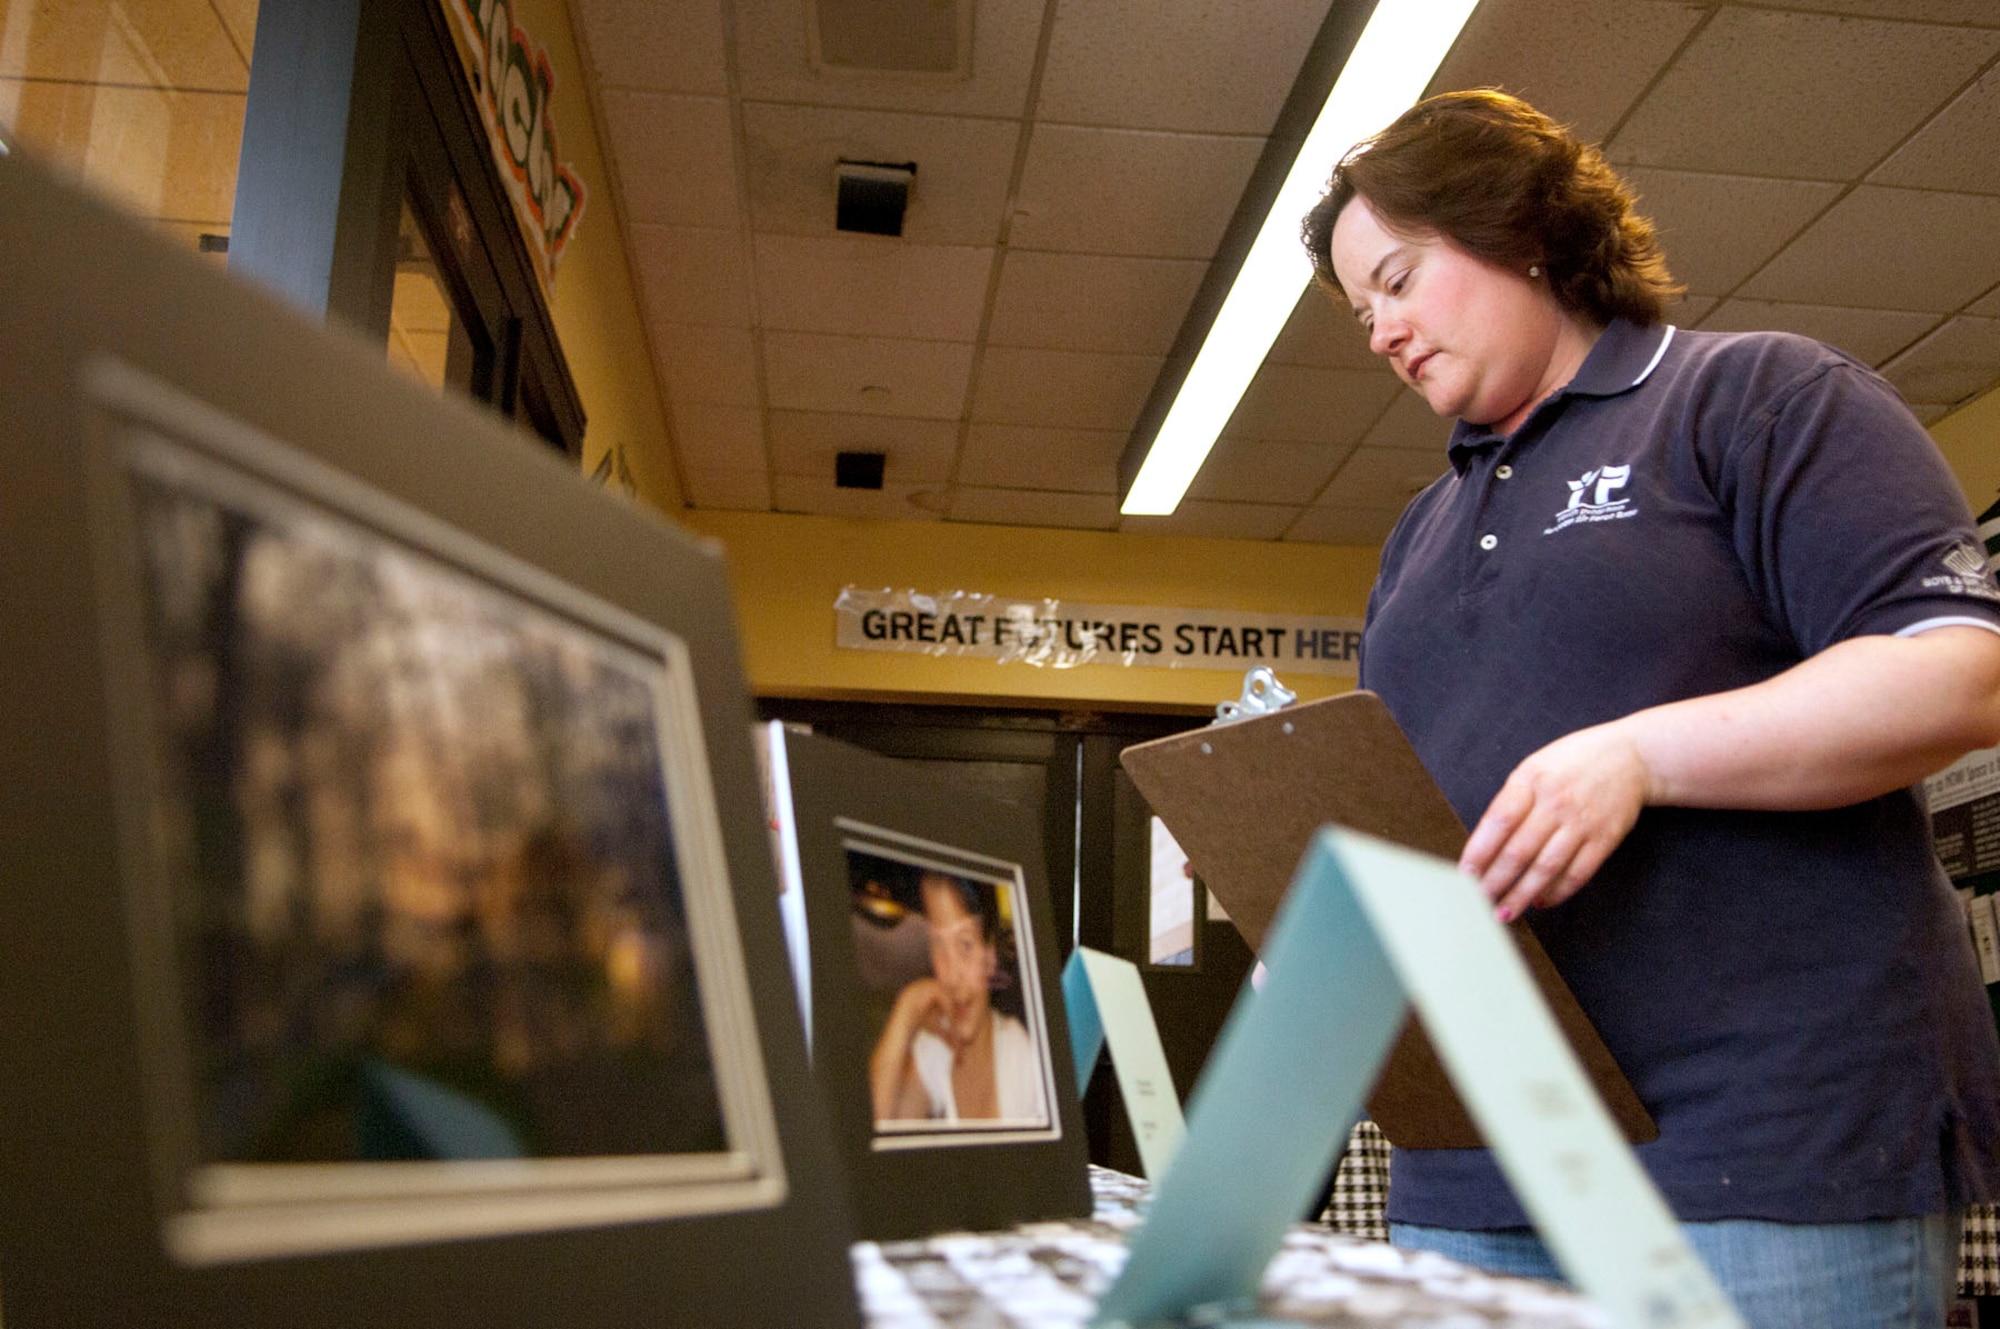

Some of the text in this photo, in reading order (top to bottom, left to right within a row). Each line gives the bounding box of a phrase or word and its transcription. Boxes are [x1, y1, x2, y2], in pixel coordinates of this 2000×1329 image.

[862, 610, 985, 645] GREAT
[1174, 624, 1286, 658] START
[1295, 630, 1361, 661] HER
